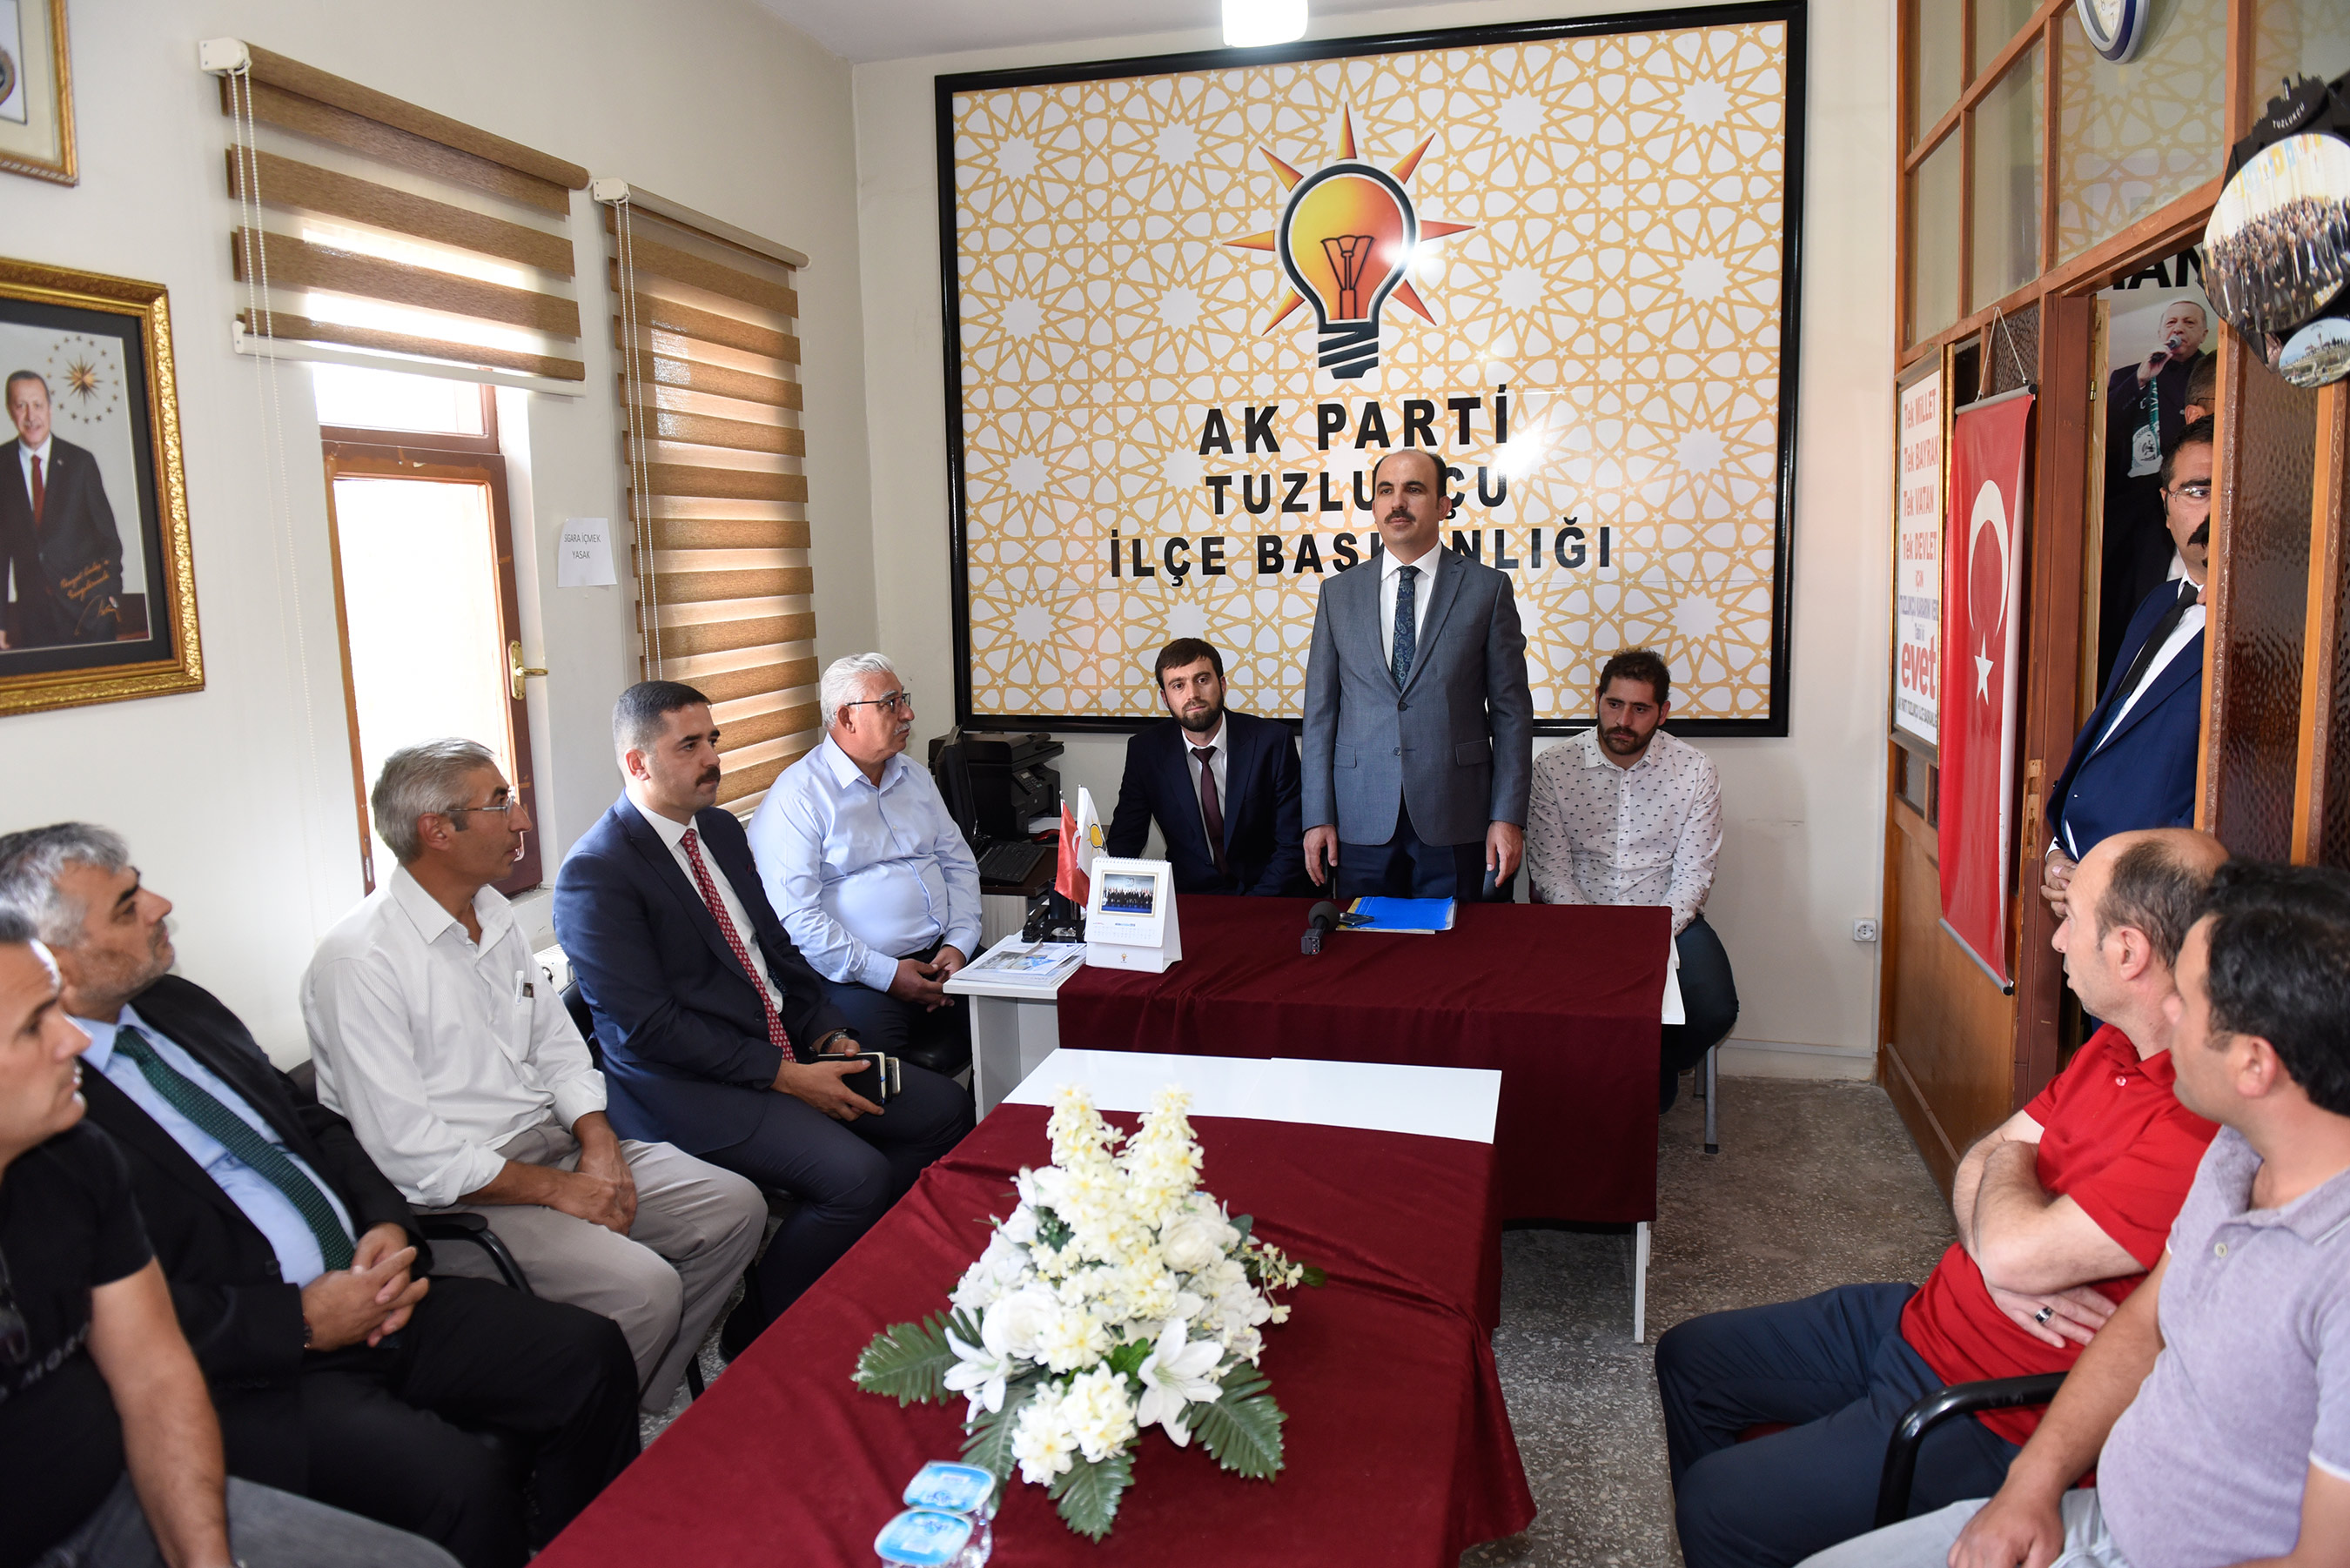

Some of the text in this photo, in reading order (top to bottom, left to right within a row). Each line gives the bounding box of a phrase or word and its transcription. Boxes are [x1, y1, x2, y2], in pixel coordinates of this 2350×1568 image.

[1198, 384, 1507, 455] AK PARTİ
[1904, 400, 1914, 431] Tek
[1904, 434, 1939, 474] Tek BAYRAK
[1205, 466, 1507, 520] TUZLUÇU
[1904, 484, 1934, 517] Tek VATAN
[572, 550, 591, 560] YASAK
[581, 533, 601, 545] İÇMEK
[1903, 531, 1937, 560] Tek DEVLET
[1111, 529, 1226, 587] İLÇE
[1902, 634, 1937, 700] evet
